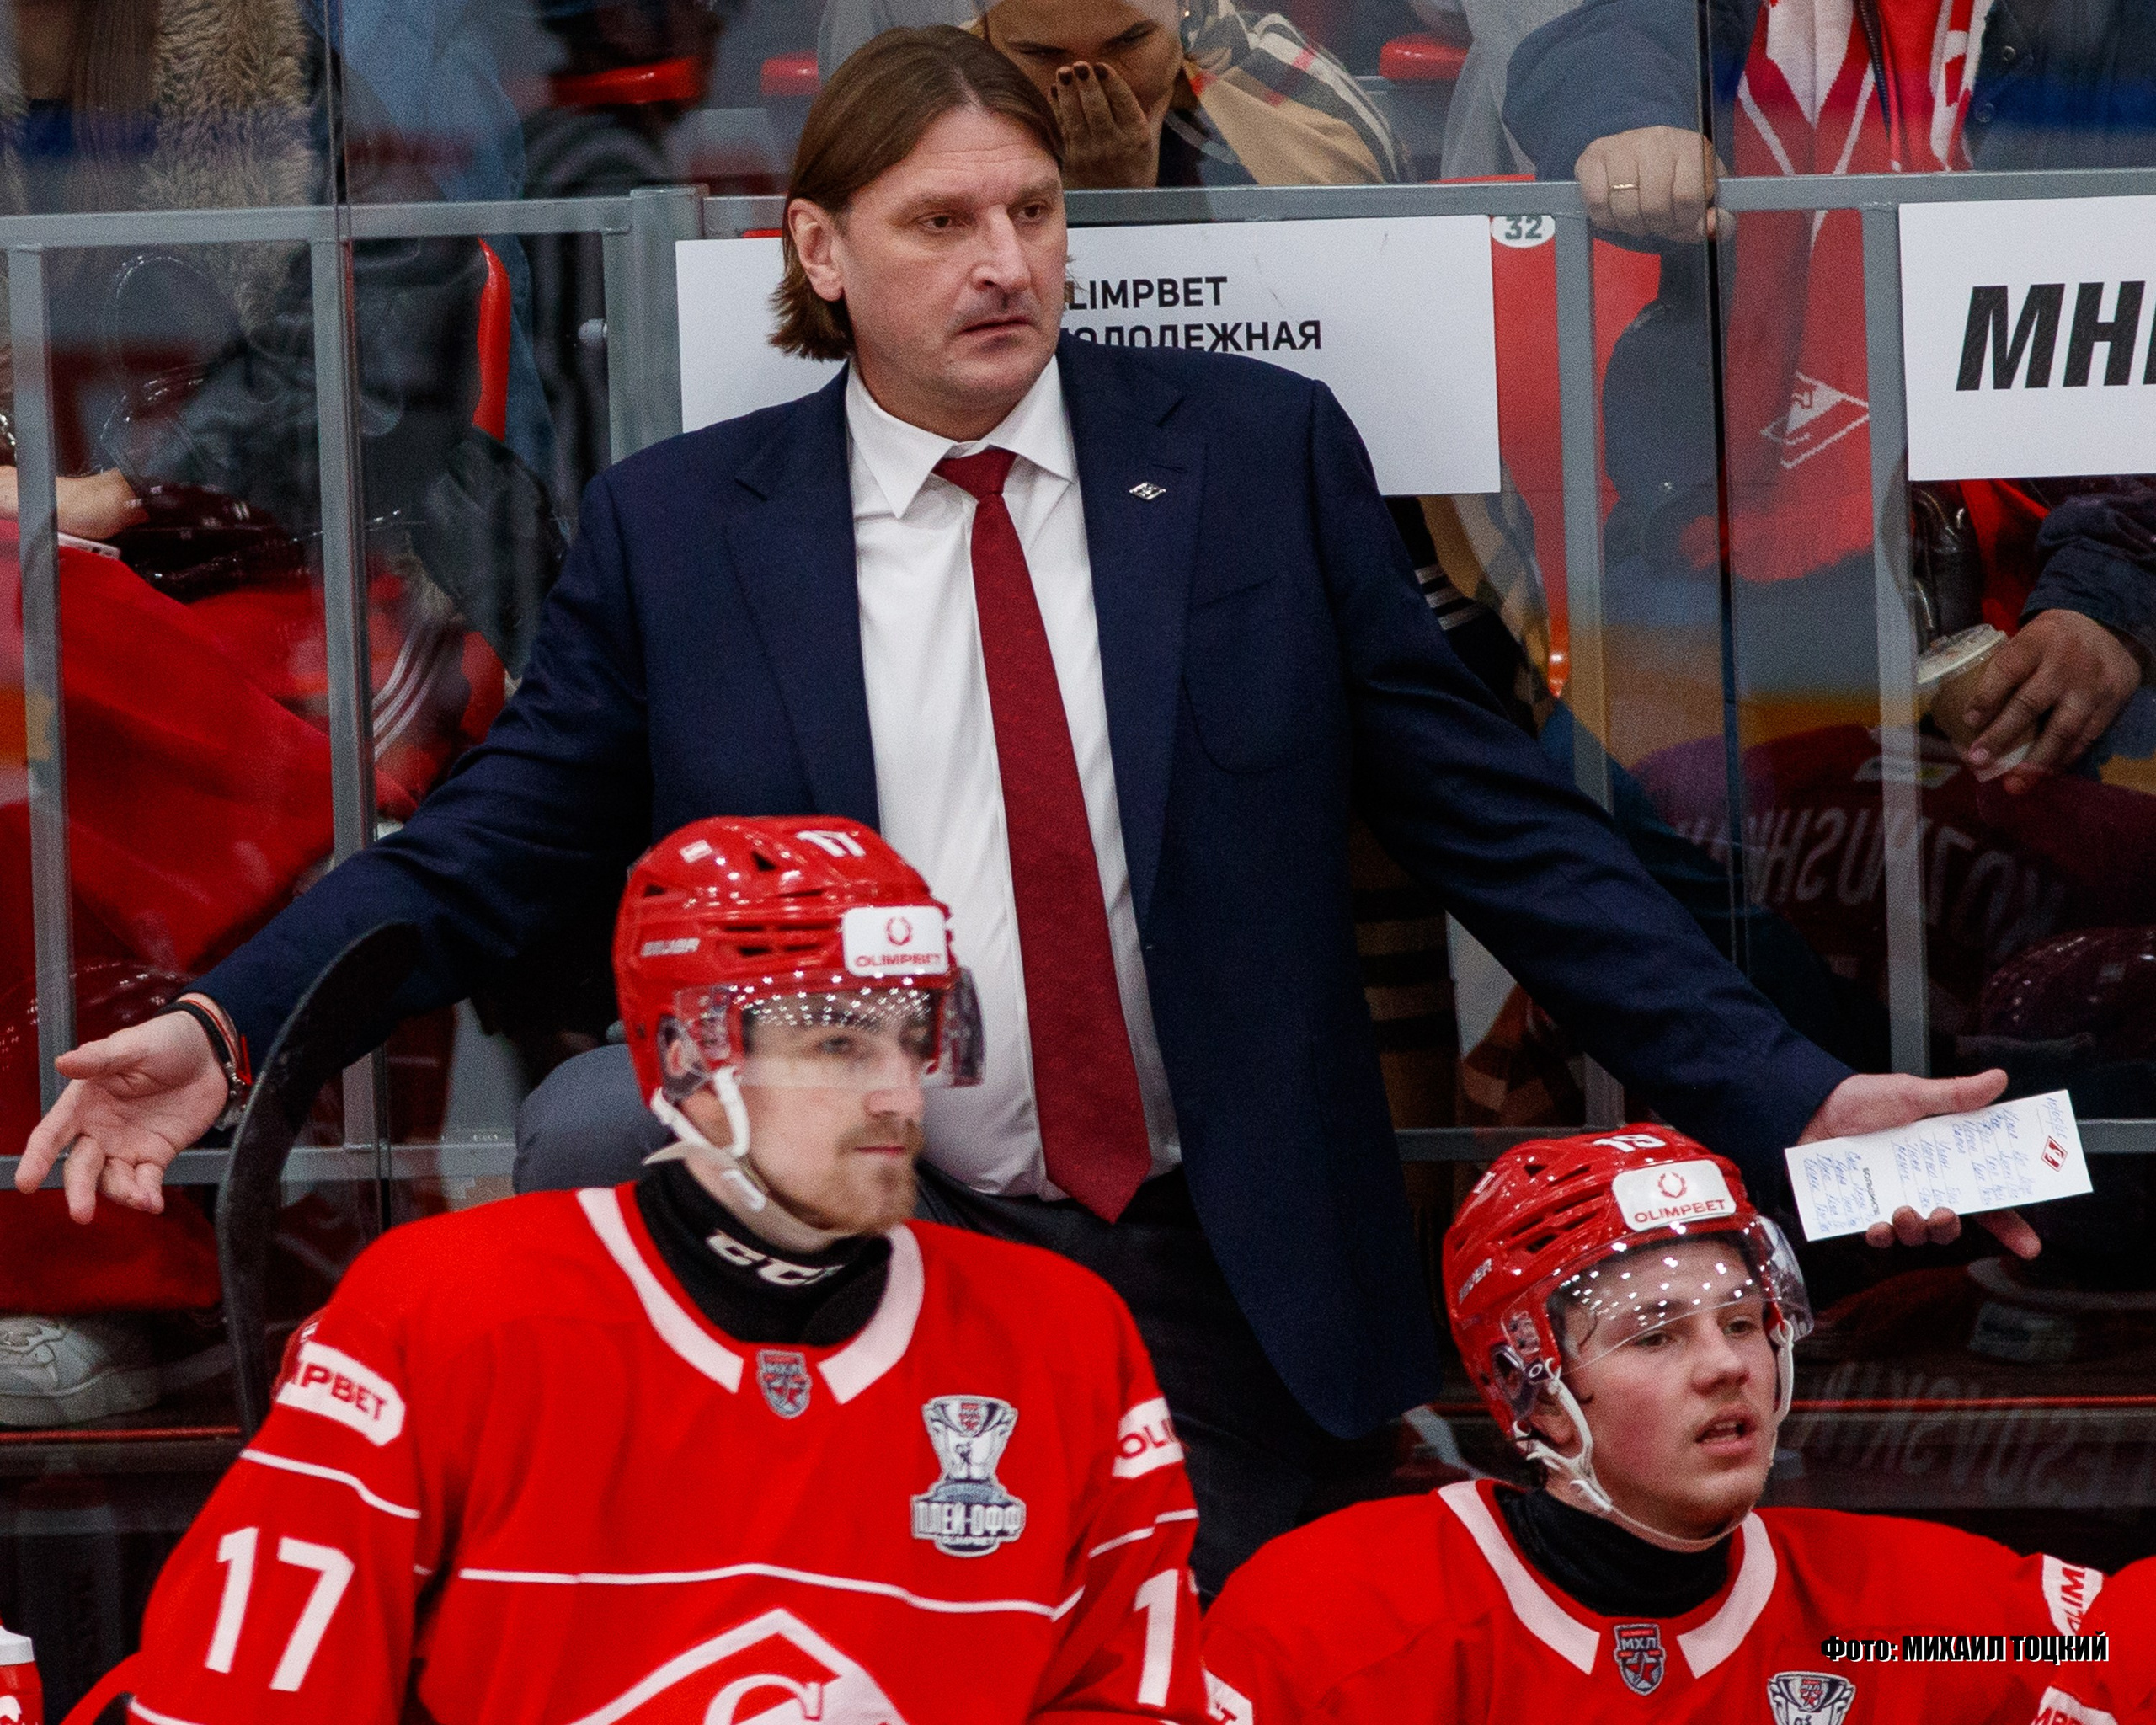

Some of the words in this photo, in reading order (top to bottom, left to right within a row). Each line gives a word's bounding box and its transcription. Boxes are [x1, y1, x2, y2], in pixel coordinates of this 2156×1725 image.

[1505, 213, 1542, 240] 32
[1068, 275, 1228, 311] LIMPBET
[1955, 280, 2156, 393] МН
[1634, 1199, 1726, 1223] OLIMPBET
[204, 1526, 356, 1694] 17
[1133, 1567, 1182, 1709] 1
[1620, 1637, 1657, 1651] МХЛ
